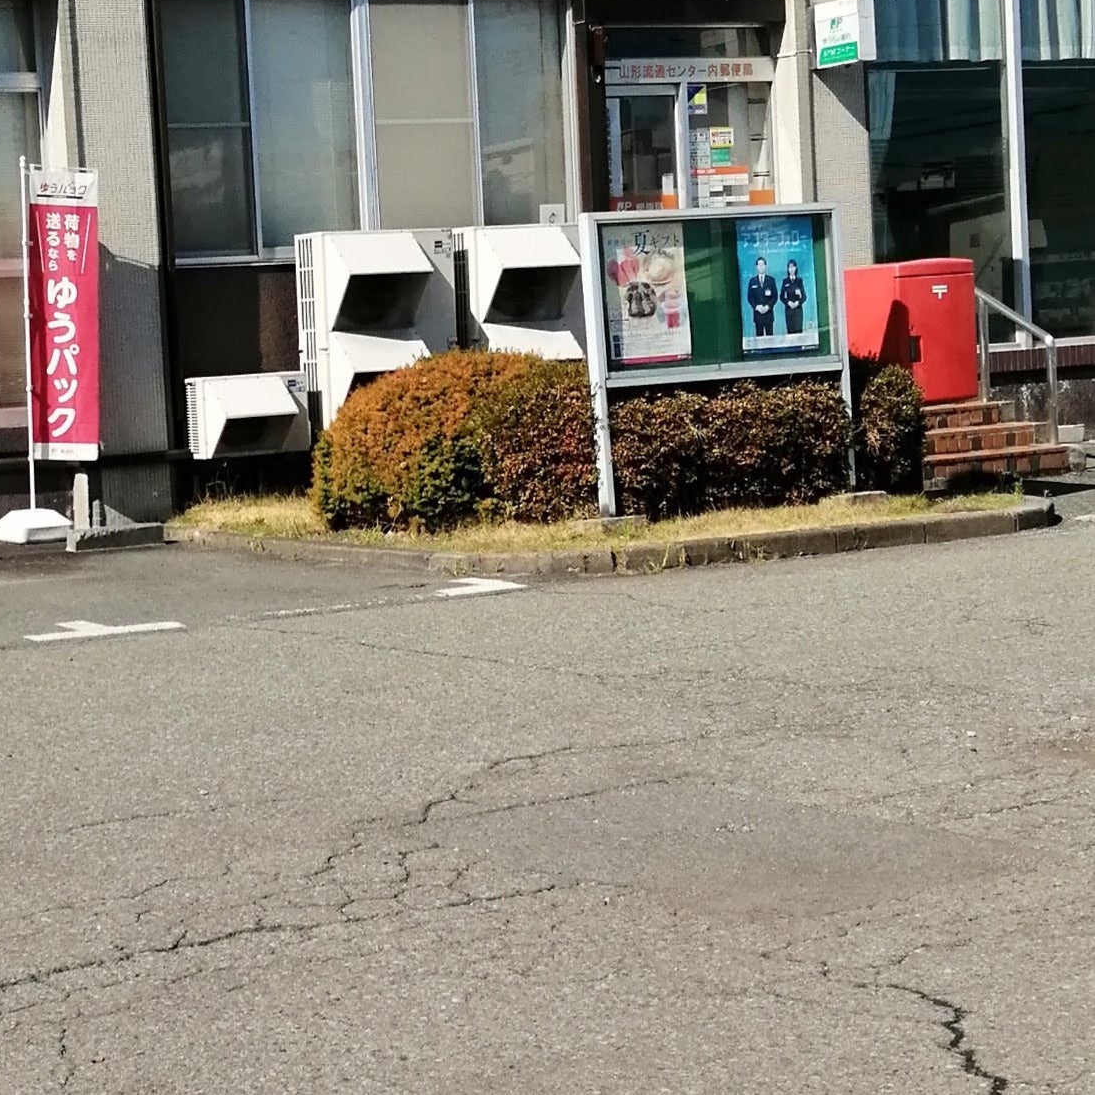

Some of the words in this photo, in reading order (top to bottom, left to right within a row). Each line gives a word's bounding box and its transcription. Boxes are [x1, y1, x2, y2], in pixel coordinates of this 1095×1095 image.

[619, 63, 753, 79] 山形流通センター内郵便局
[46, 212, 61, 272] 送るなら
[64, 213, 80, 261] 荷物を
[46, 276, 80, 437] ゆうパック
